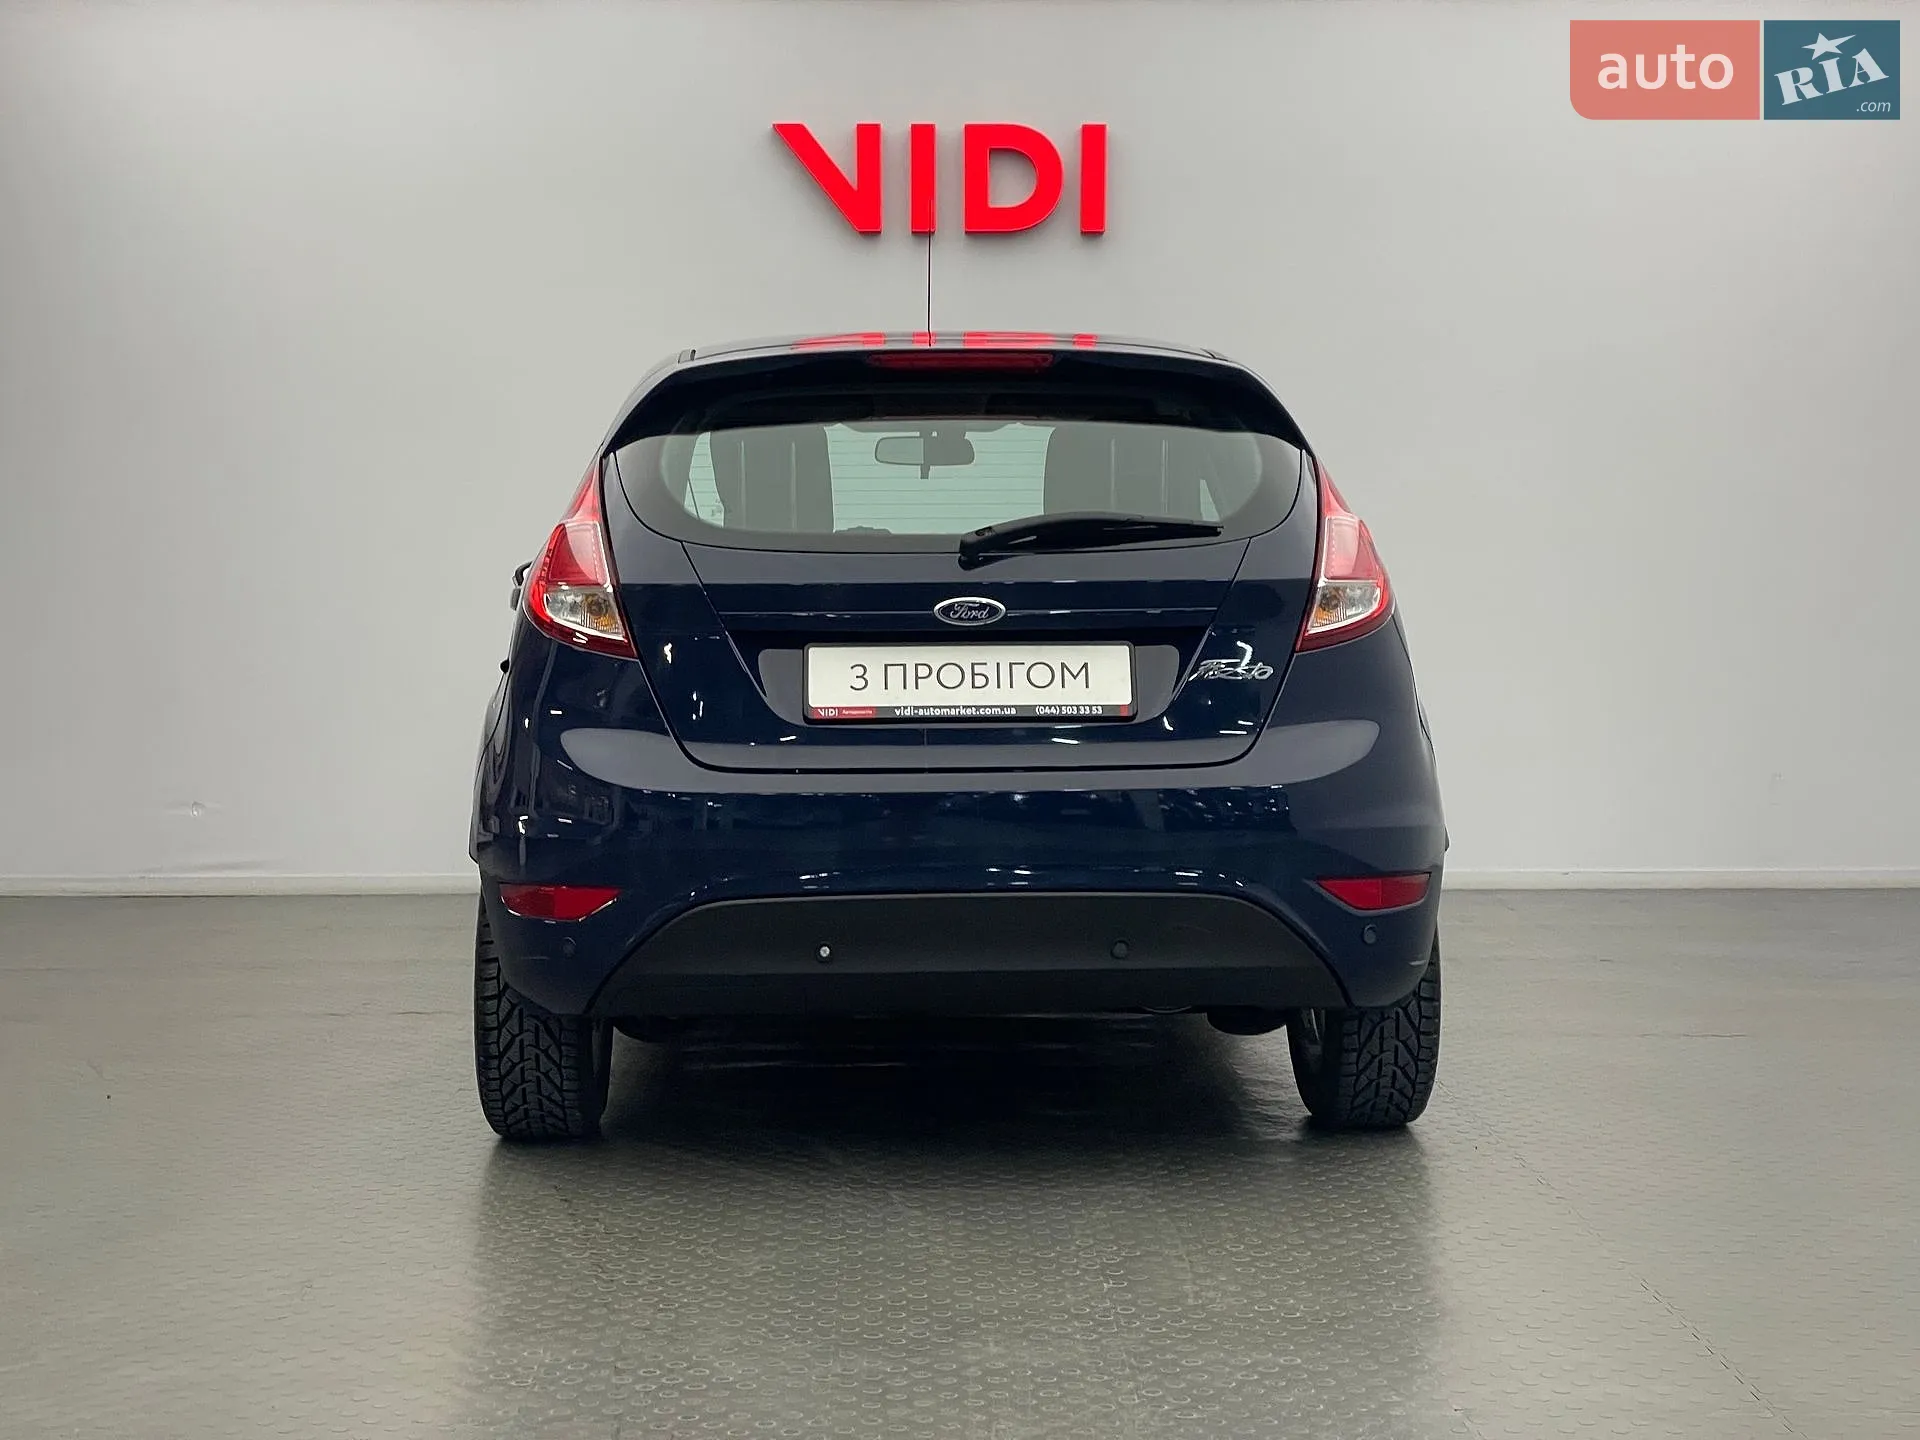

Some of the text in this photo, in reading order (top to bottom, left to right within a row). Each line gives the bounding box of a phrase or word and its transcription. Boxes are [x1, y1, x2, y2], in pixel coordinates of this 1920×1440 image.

[772, 122, 1107, 235] VIDI
[949, 602, 990, 619] Ford
[884, 661, 1090, 690] ПРОБІГОМ
[817, 708, 839, 717] VIDI
[894, 704, 1103, 717] vidi-automarket.com.ua (044) 503 33 53
